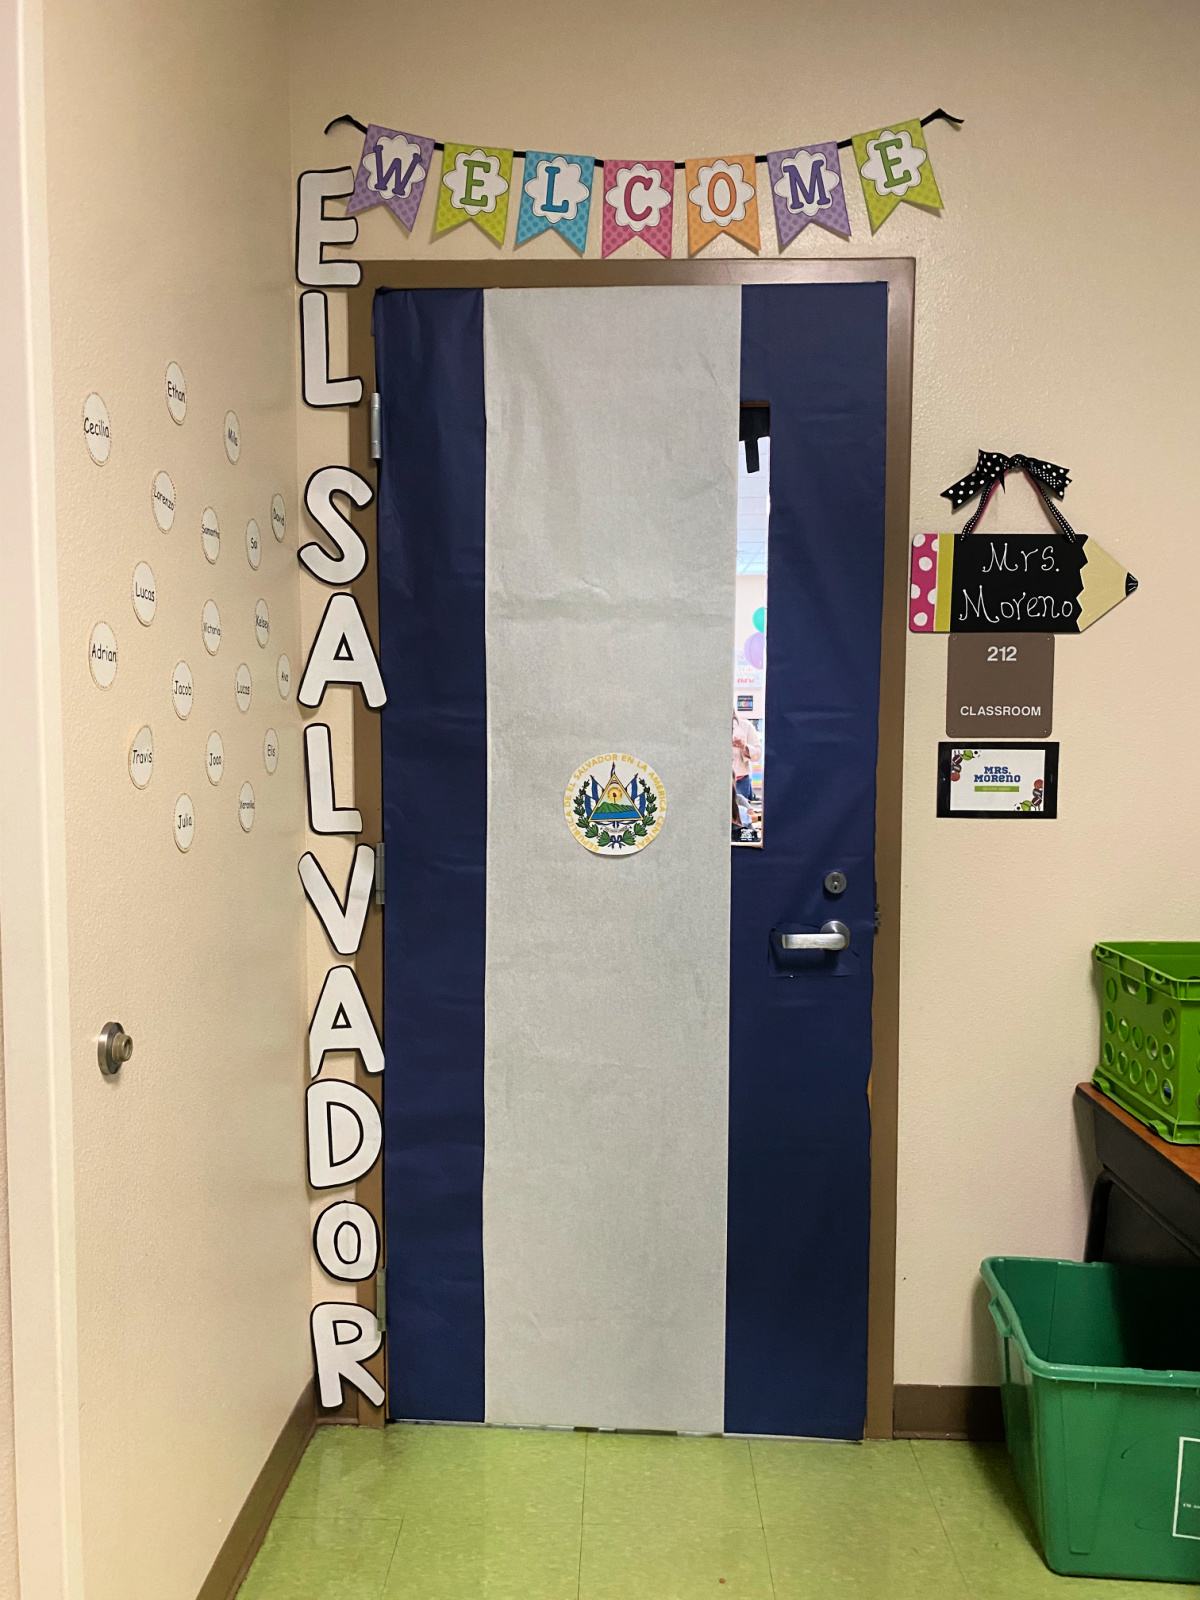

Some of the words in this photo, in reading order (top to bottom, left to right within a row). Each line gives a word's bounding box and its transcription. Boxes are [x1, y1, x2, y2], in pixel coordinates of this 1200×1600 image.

[371, 137, 912, 222] WELCOME
[296, 166, 363, 407] EL
[167, 381, 186, 403] Ethan
[83, 417, 110, 439] Cecilia
[153, 488, 174, 511] Lorenzo
[981, 541, 1060, 573] Mrs.
[135, 582, 155, 602] Lucas
[958, 584, 1074, 623] Moreno
[91, 644, 117, 663] Adrian
[986, 646, 1018, 662] 212
[174, 680, 192, 696] Jacob
[960, 705, 1042, 717] CLASSROOM
[132, 748, 153, 765] Travis
[983, 766, 1012, 775] MRS.
[297, 465, 388, 1408] SALVADOR
